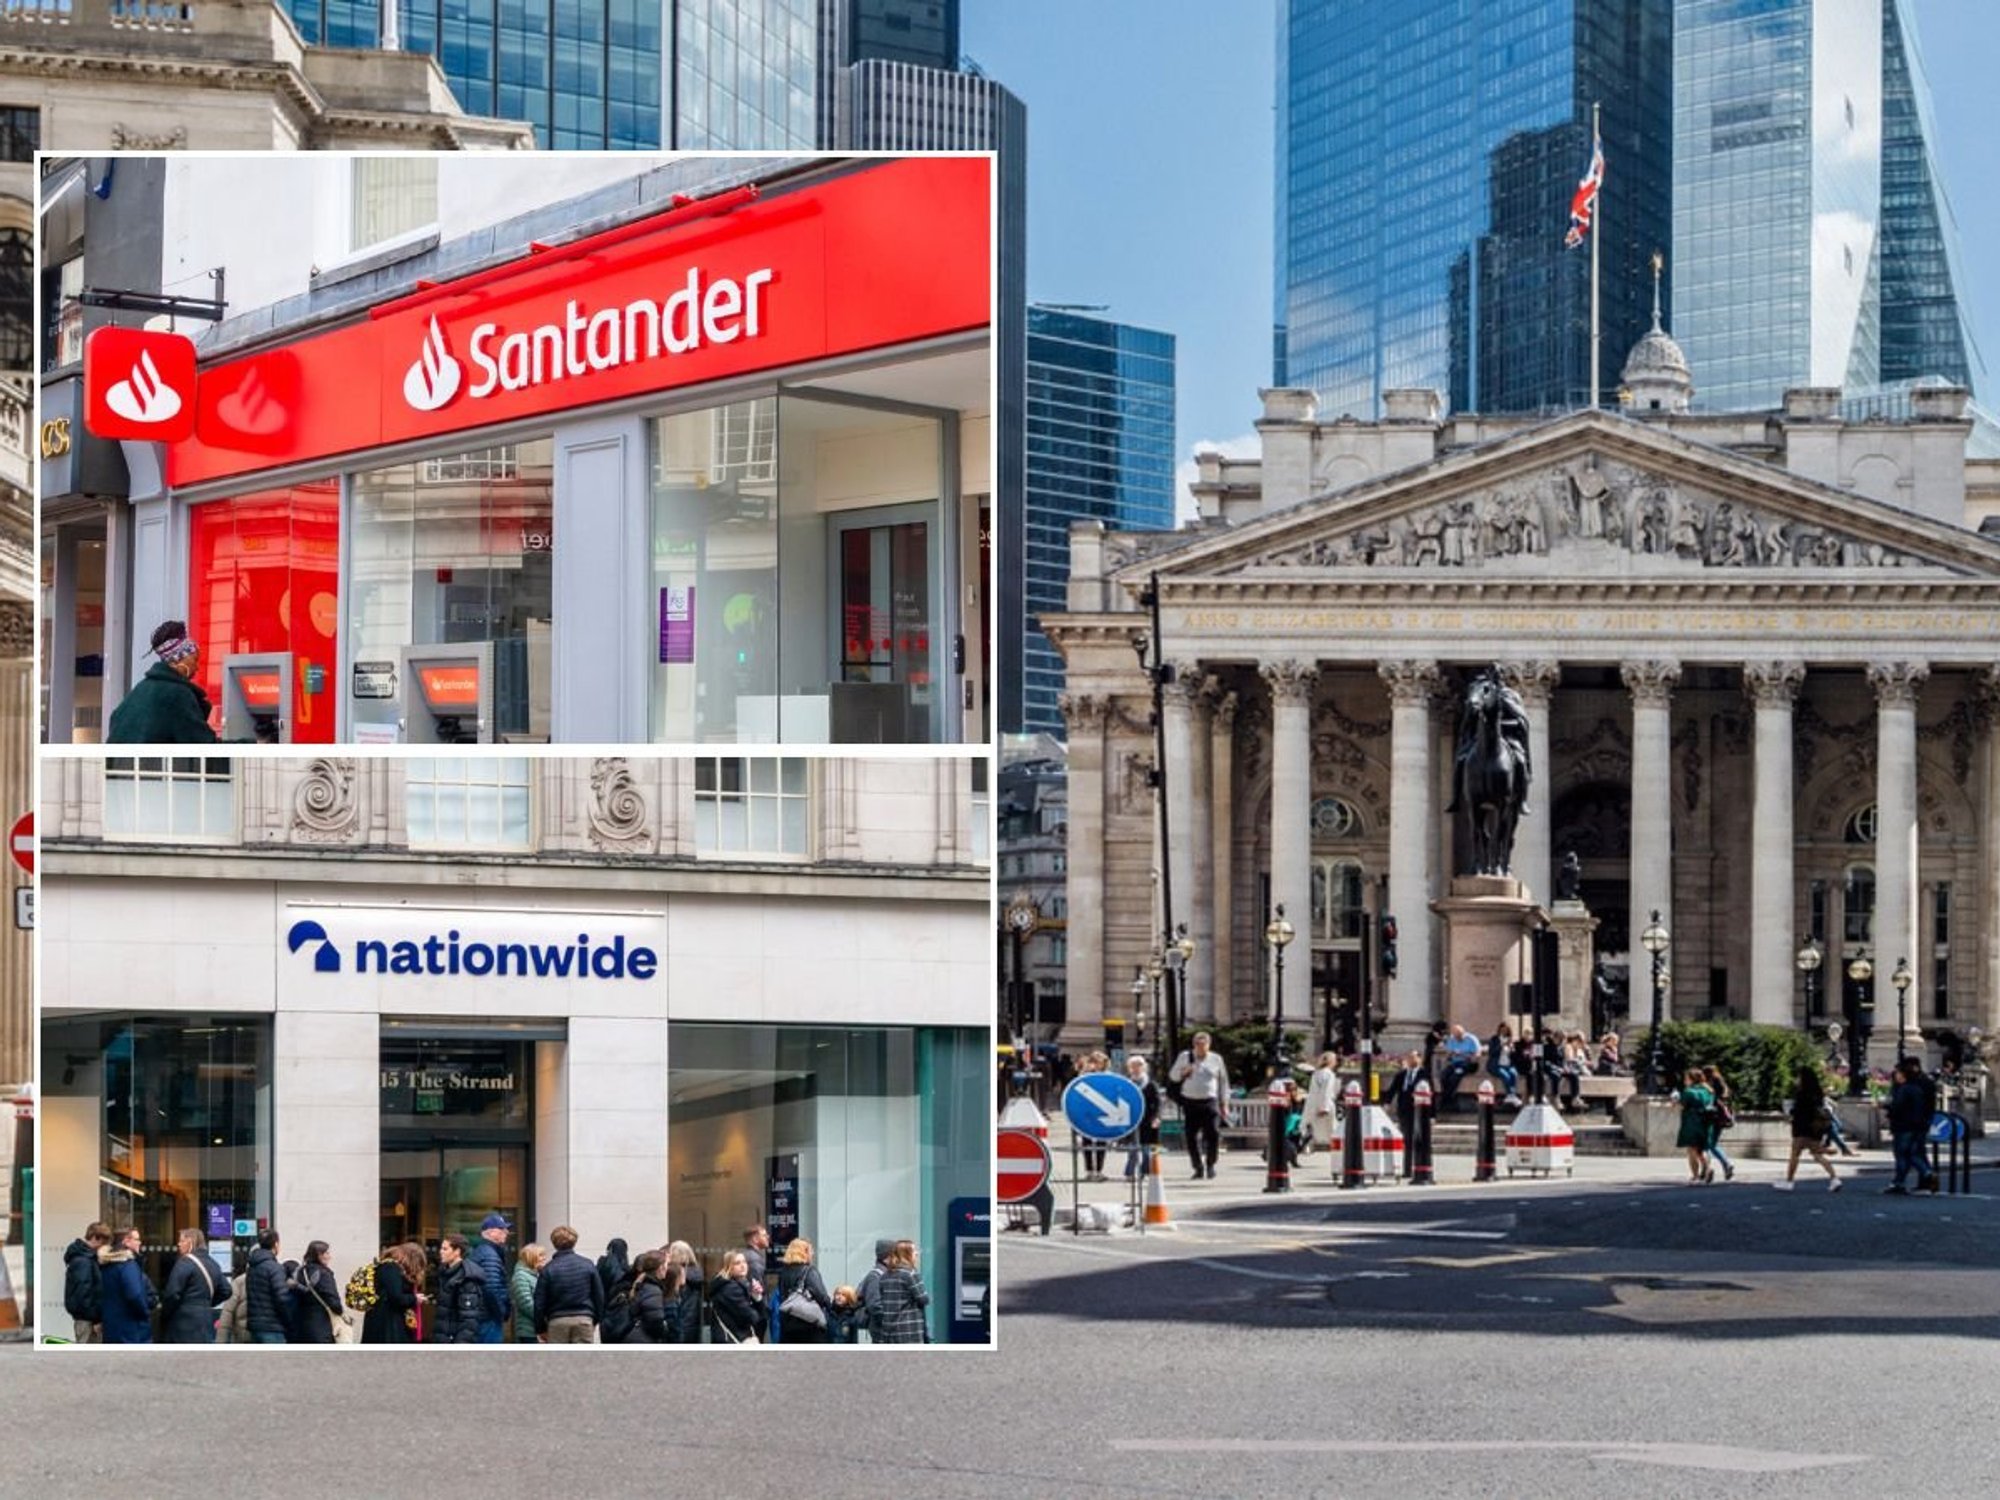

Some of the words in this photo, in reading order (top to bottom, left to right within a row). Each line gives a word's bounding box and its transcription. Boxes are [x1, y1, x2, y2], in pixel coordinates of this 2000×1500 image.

[469, 267, 772, 398] Santander
[356, 930, 658, 980] nationwide
[405, 1070, 444, 1088] The
[449, 1071, 514, 1090] Strand
